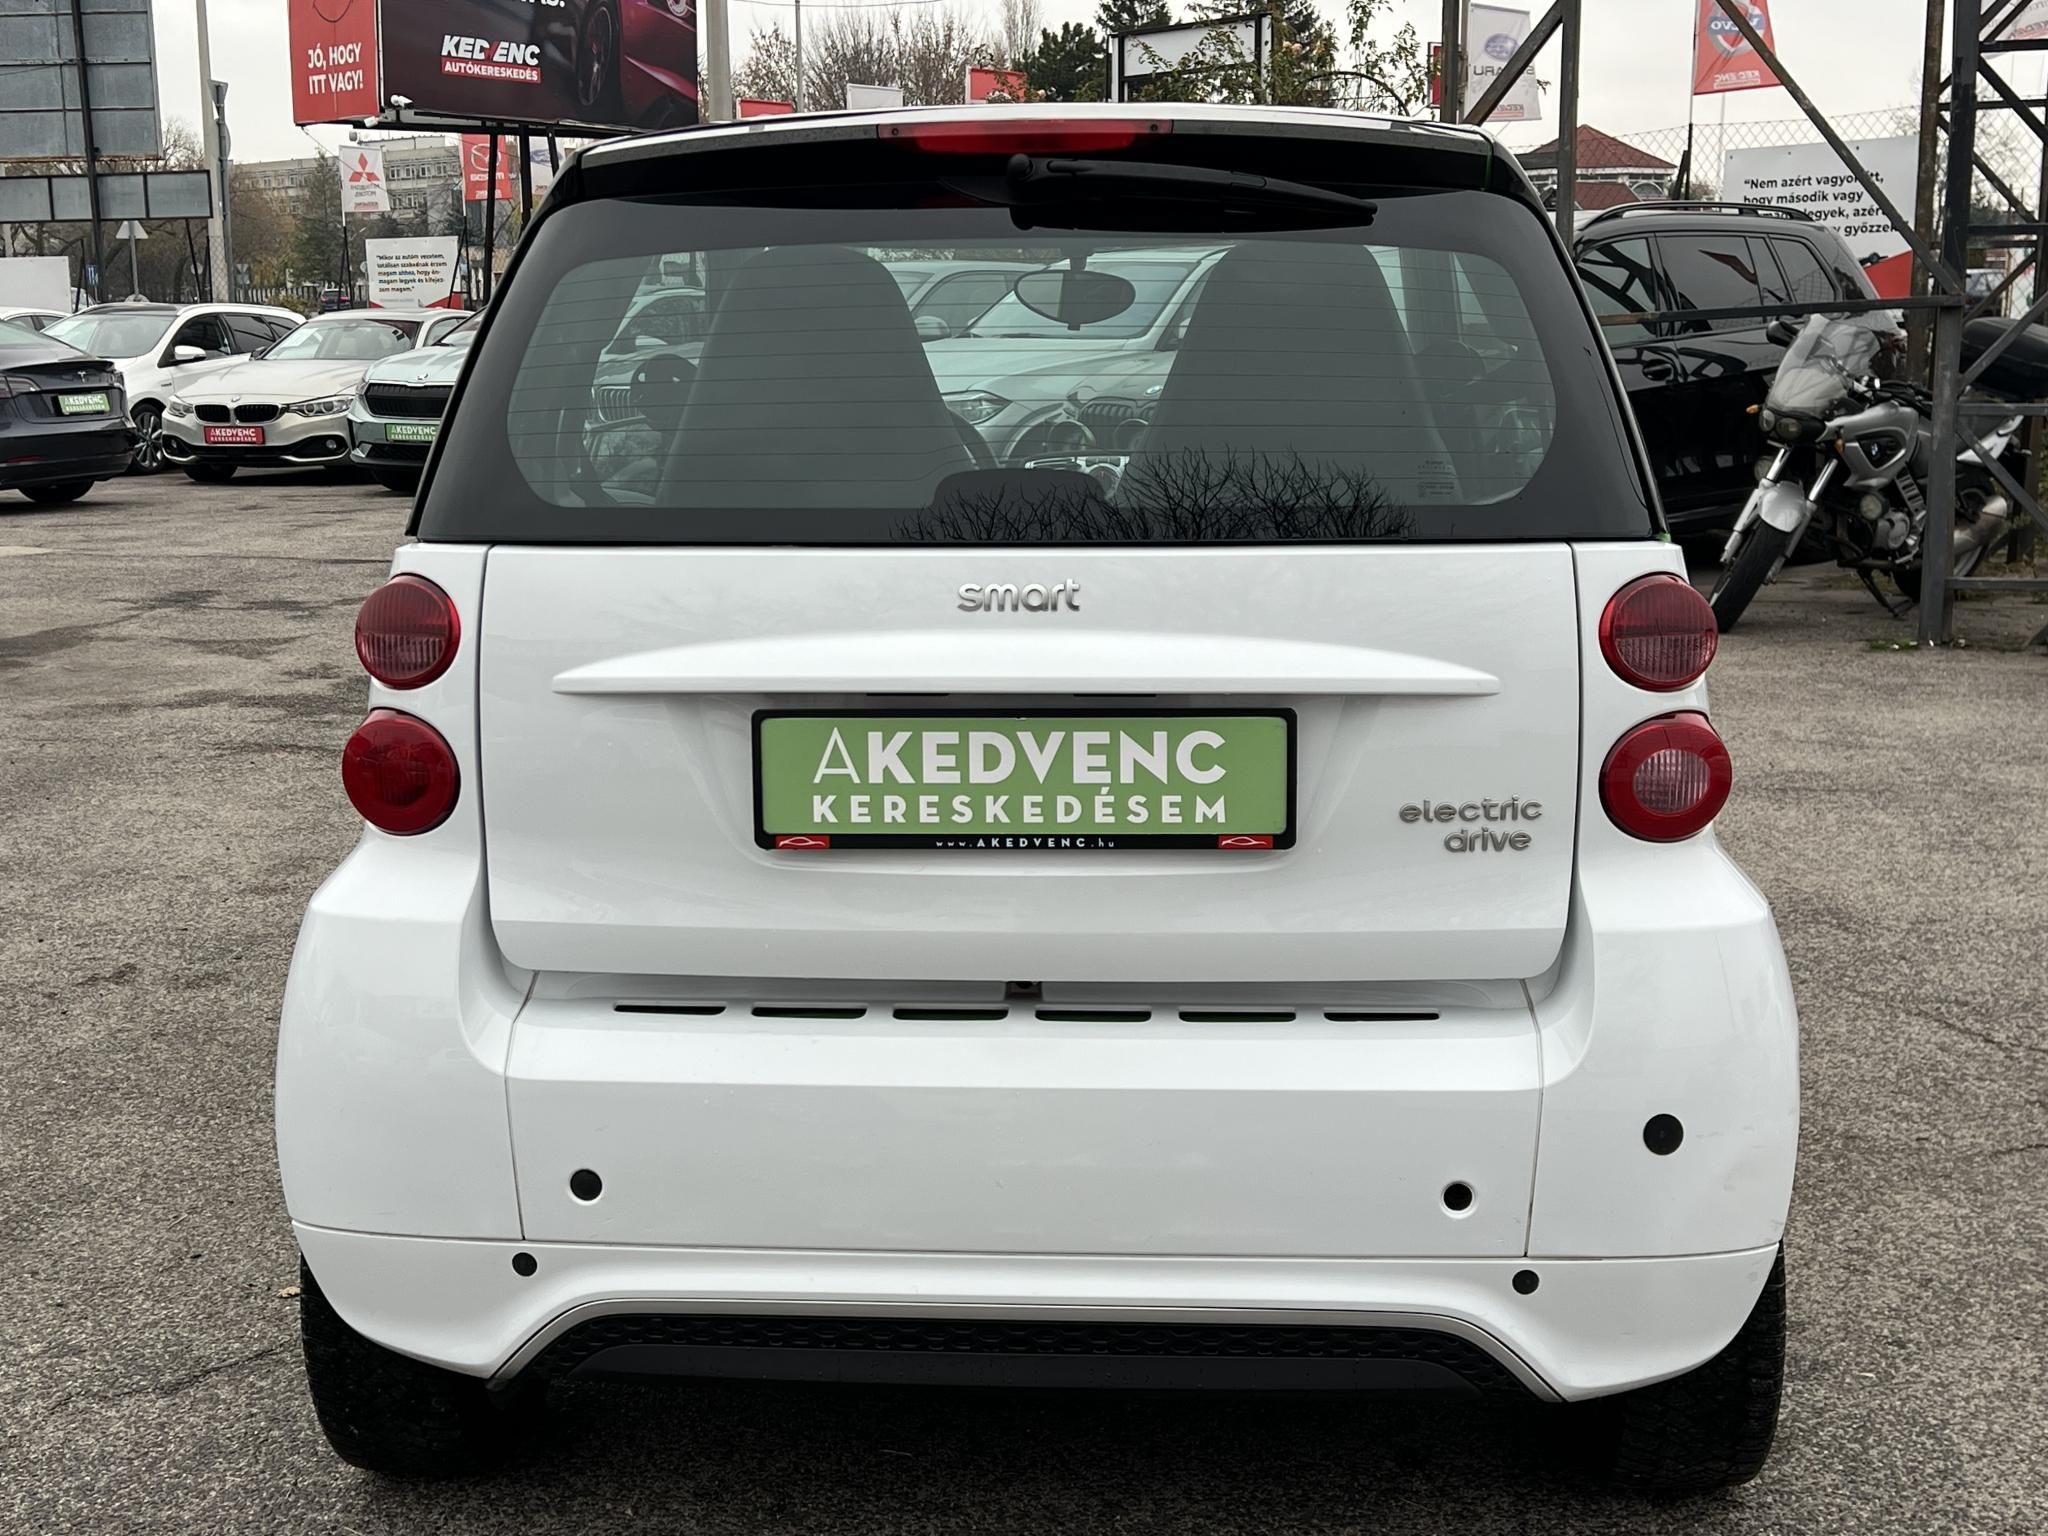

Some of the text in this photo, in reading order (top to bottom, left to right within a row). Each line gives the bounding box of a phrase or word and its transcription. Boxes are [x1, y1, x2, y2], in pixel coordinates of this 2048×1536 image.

[308, 42, 362, 71] JÓ, HOGY
[309, 69, 363, 95] ITT VAGY!
[445, 61, 539, 81] AUTÓKERESKEDÉS
[1781, 174, 1812, 188] azért
[1776, 191, 1829, 204] második
[1833, 191, 1864, 203] vagy
[210, 428, 256, 437] AKEDVENC
[391, 424, 437, 435] AKEDVENC
[957, 578, 1080, 612] smart
[813, 726, 1228, 785] AKEDVENC
[813, 787, 1227, 824] KERESKEDÉSEM
[1399, 793, 1543, 824] electric
[1444, 826, 1532, 853] drive
